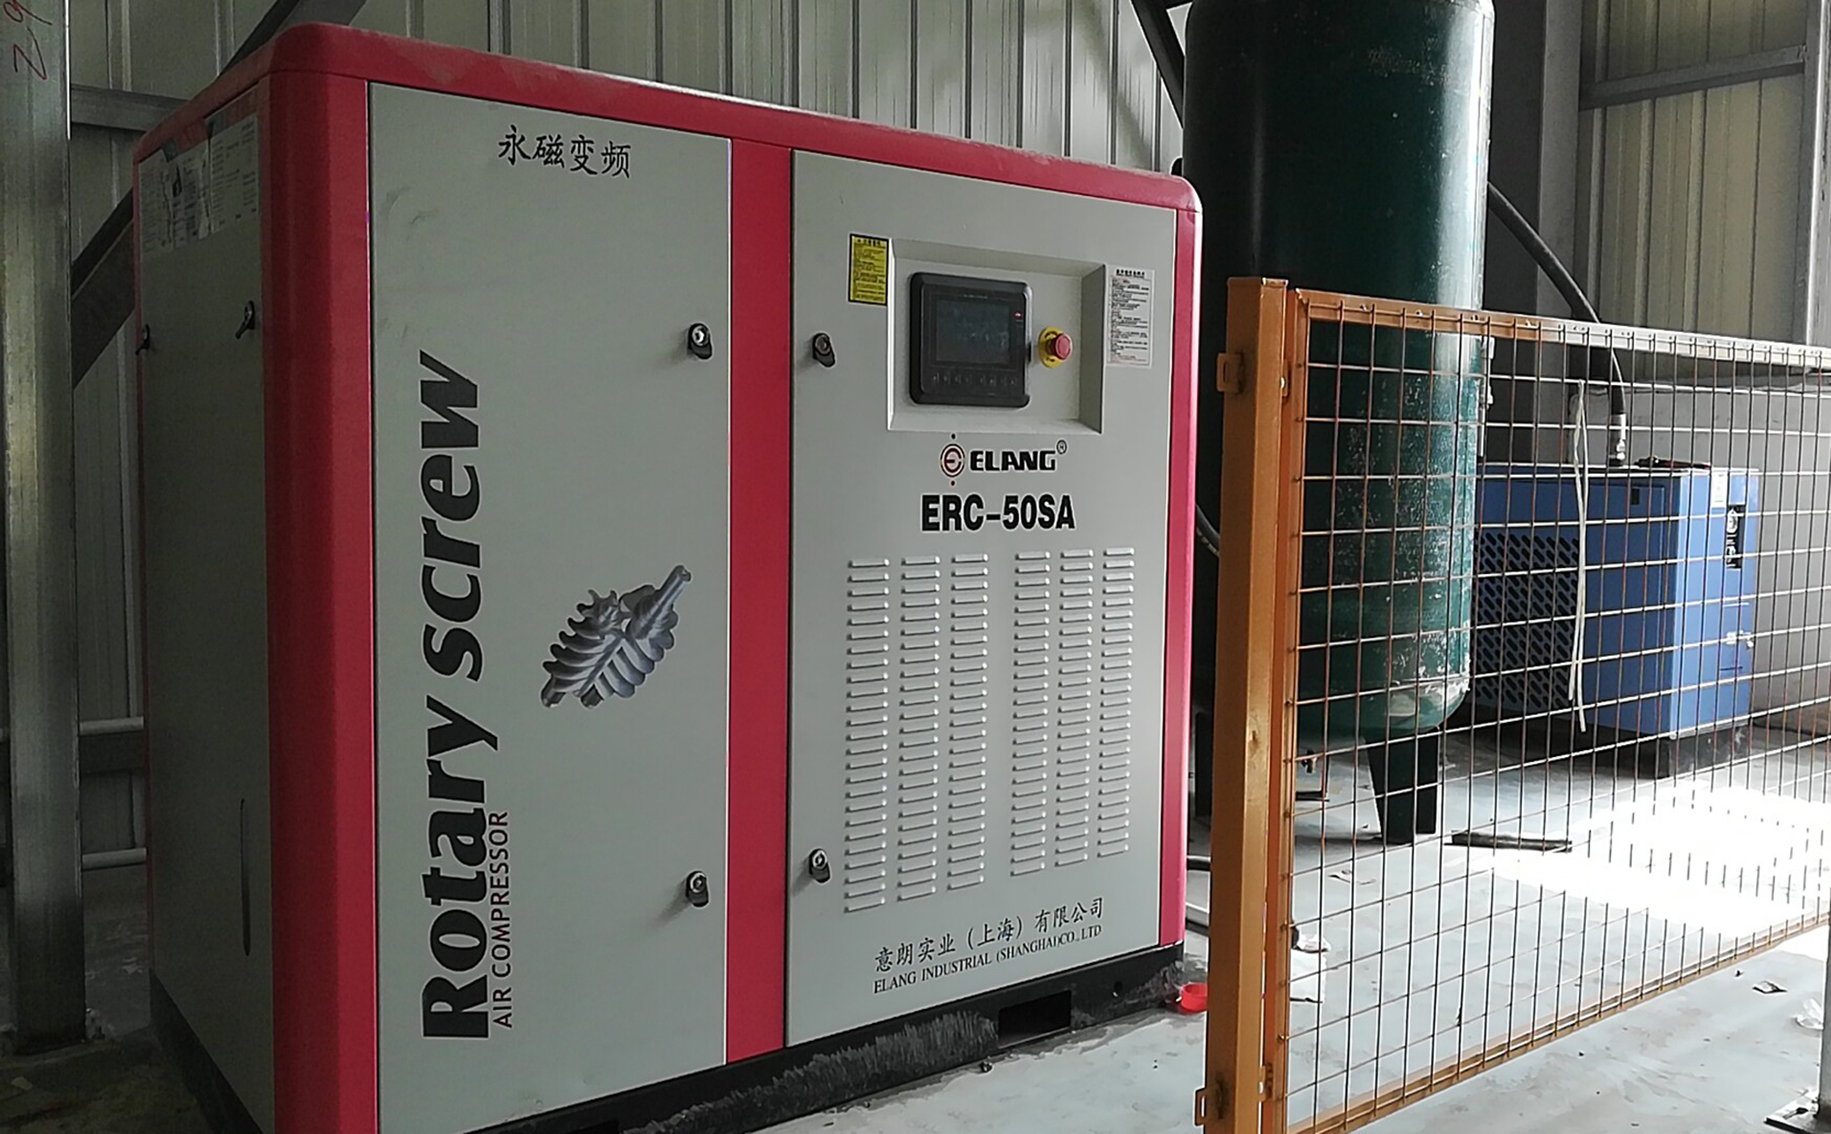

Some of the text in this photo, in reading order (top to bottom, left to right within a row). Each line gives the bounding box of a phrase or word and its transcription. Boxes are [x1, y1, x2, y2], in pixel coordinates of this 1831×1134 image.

[498, 124, 632, 179] 永磁变频
[970, 450, 1056, 471] ELANG
[922, 494, 1075, 531] ERC-50SA
[419, 350, 498, 1038] Rotary screw
[488, 812, 513, 1029] AIR COMPRESSOR
[873, 971, 917, 994] ELANG
[921, 952, 992, 981] INDUSTRIAL
